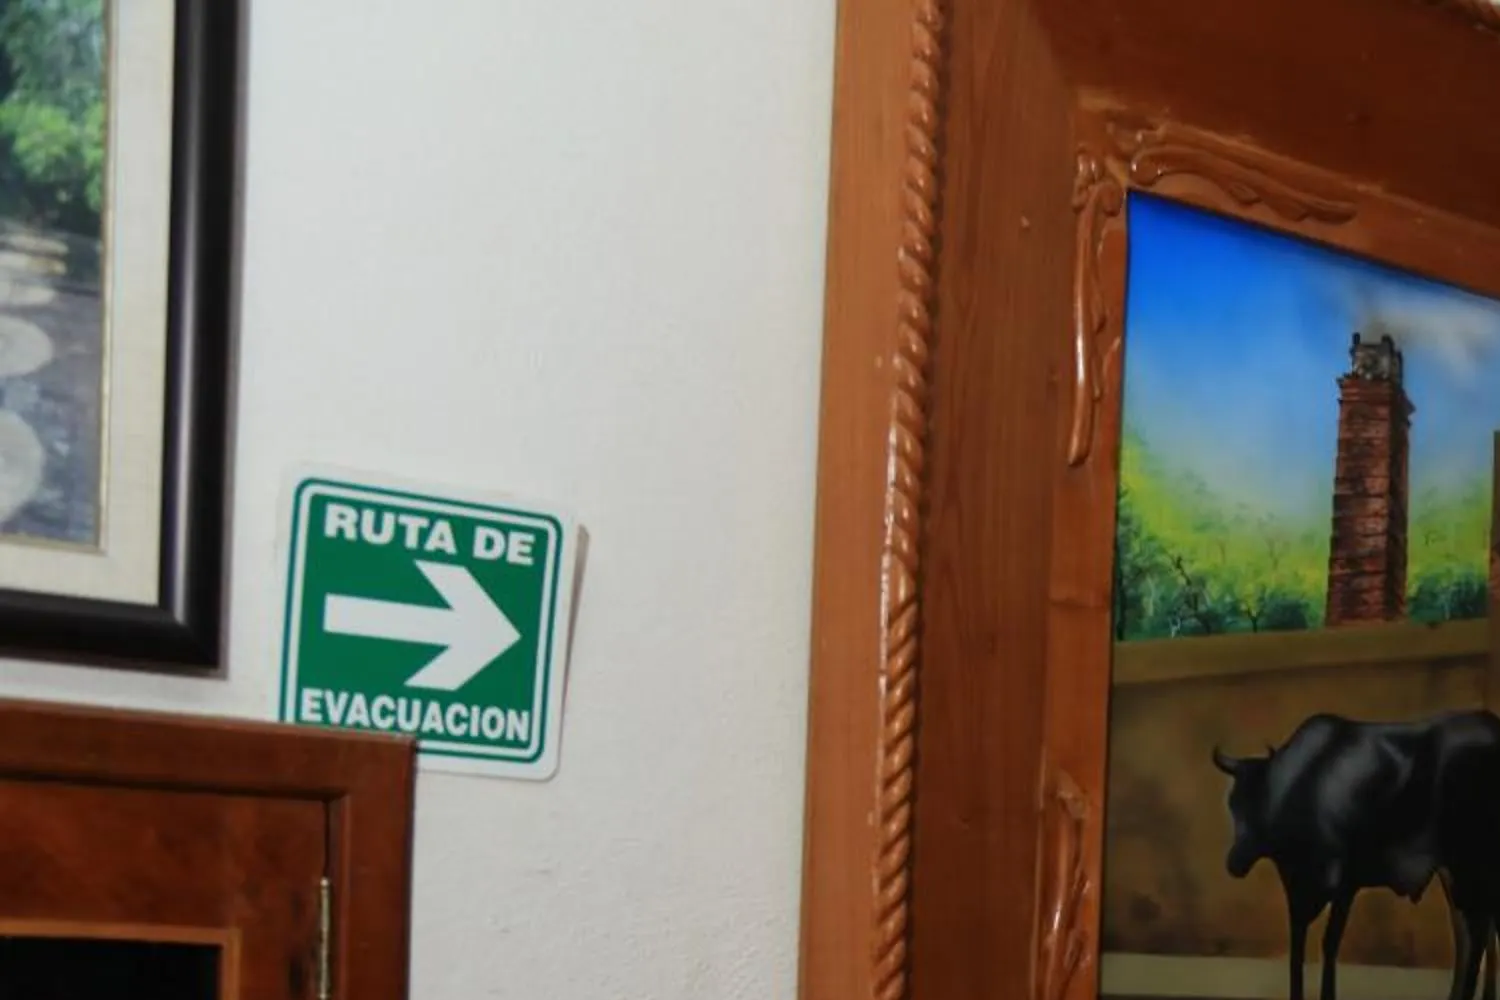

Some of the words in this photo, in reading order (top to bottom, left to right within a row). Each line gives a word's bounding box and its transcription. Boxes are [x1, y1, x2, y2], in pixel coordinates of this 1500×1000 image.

[323, 503, 457, 555] RUTA
[472, 525, 536, 566] DE
[300, 687, 530, 742] EVACUACION
